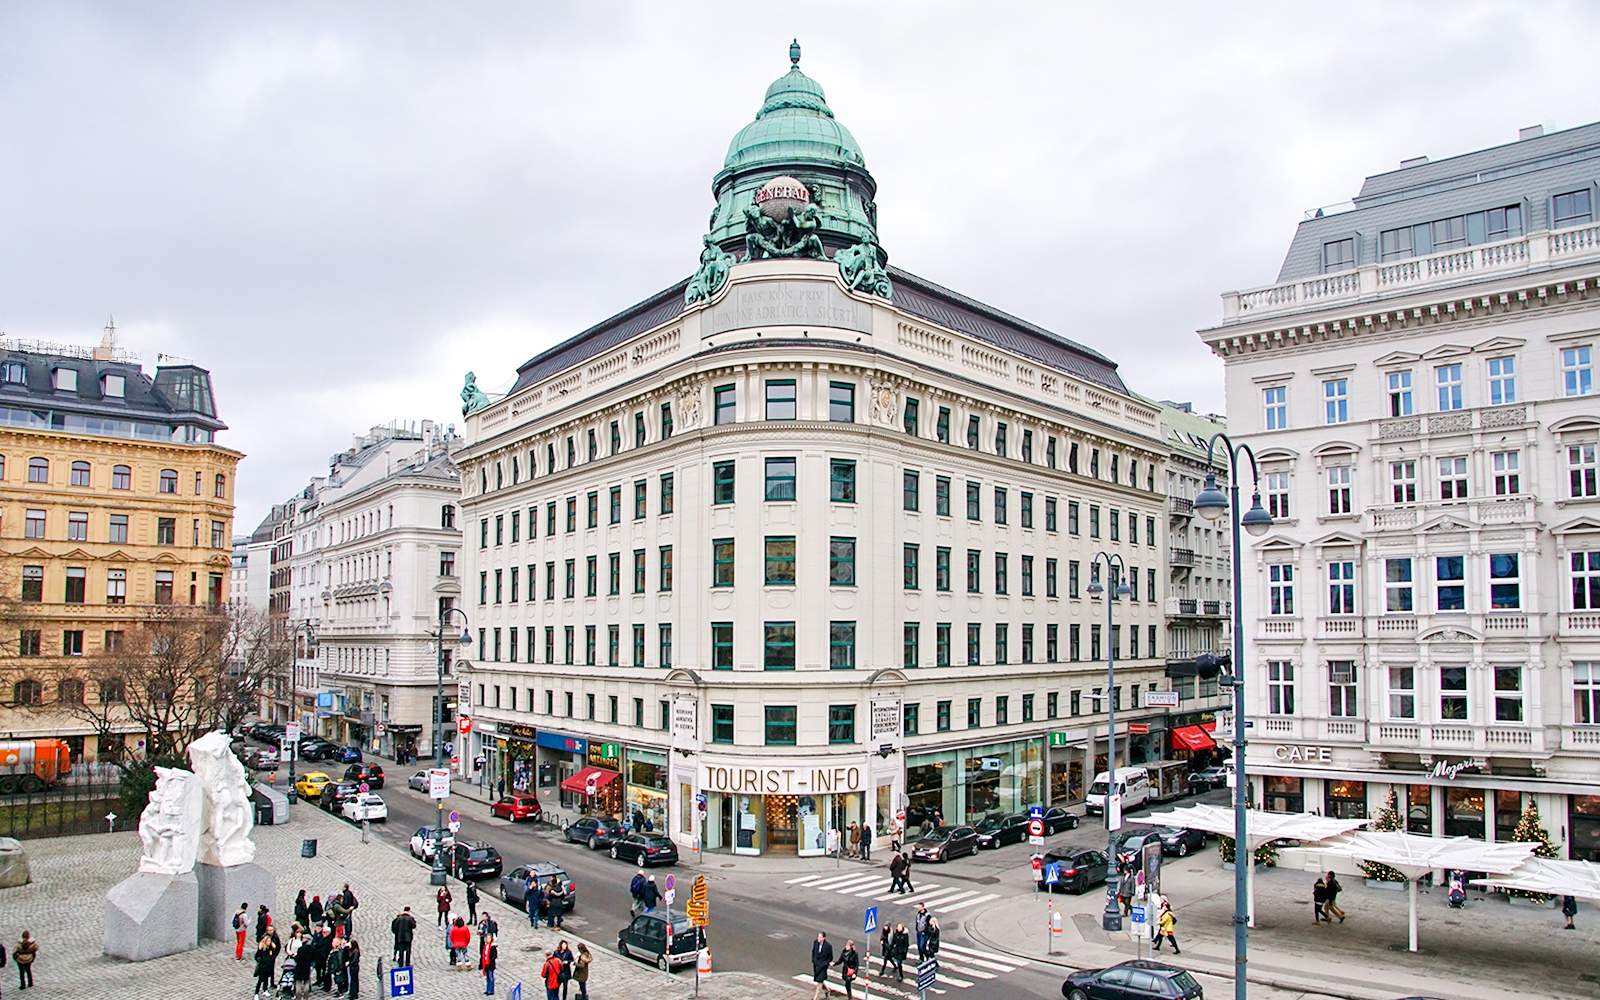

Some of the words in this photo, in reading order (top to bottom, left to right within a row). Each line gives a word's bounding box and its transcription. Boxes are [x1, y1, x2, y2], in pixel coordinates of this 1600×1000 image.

[741, 292, 766, 303] KAIS.
[799, 291, 825, 301] PRIV.
[757, 305, 809, 319] ADRIATICA
[1274, 745, 1333, 763] CAFE
